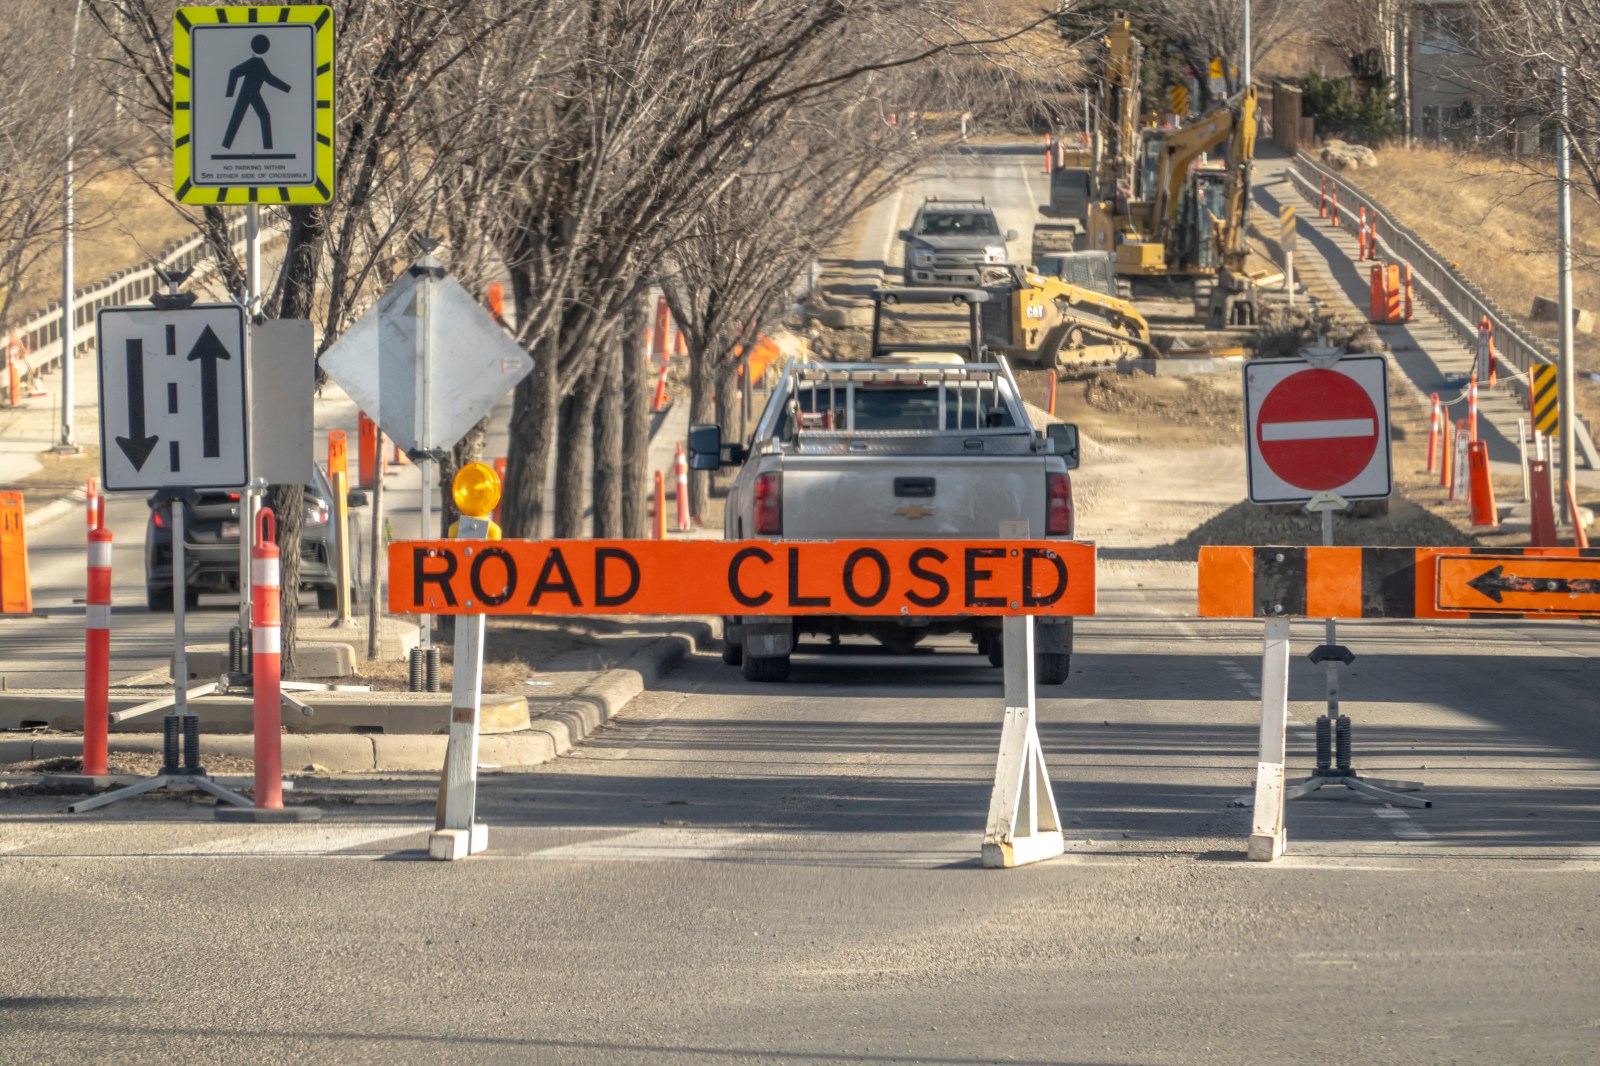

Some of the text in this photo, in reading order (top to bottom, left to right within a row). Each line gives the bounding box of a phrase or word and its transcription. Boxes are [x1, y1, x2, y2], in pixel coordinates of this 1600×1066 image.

[1026, 305, 1043, 319] CAT
[412, 547, 1069, 608] ROAD CLOSED
